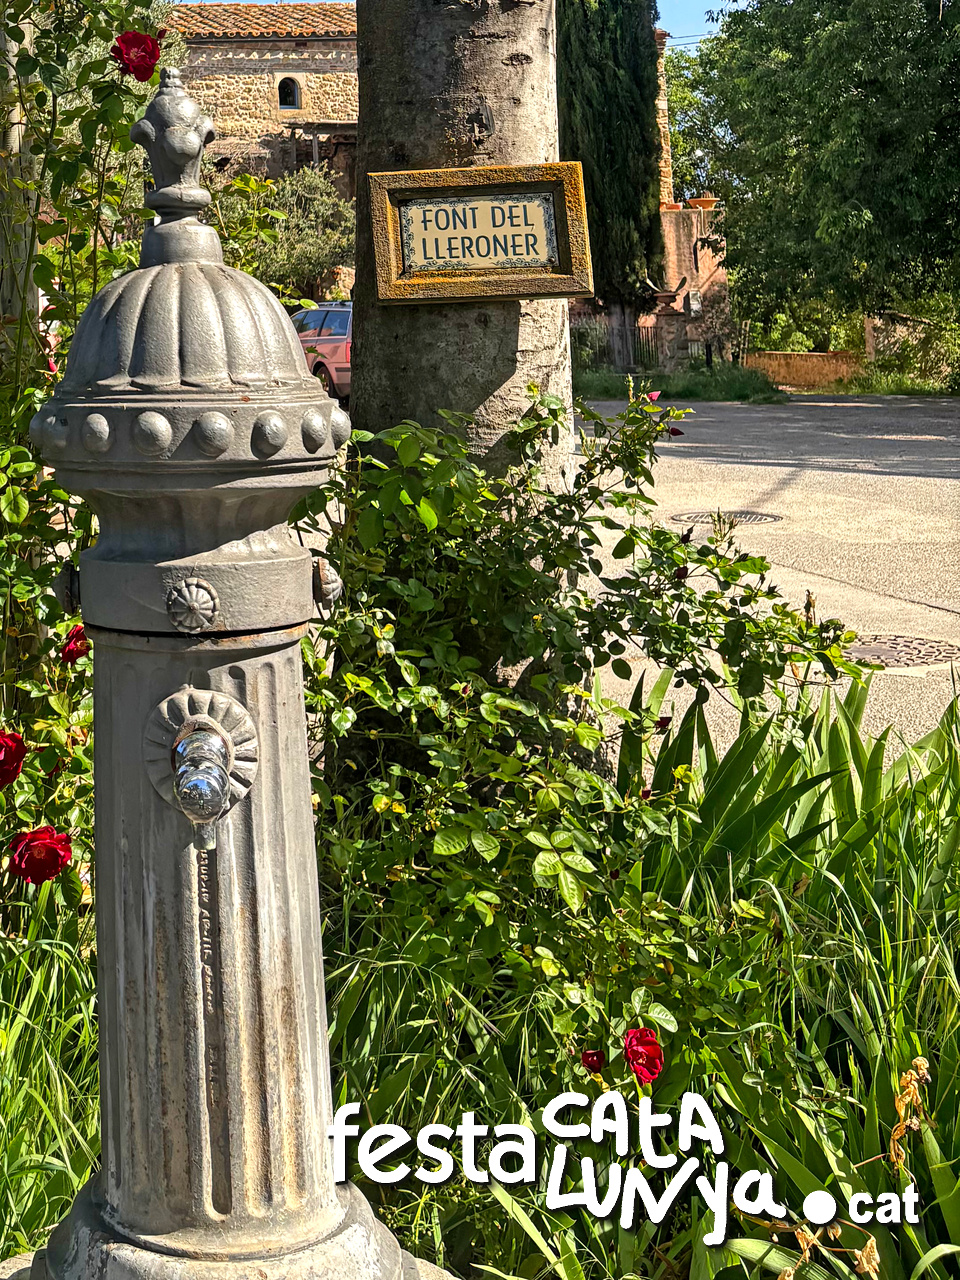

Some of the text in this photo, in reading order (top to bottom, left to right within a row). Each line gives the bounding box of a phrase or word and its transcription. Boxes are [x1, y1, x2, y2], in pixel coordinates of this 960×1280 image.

[421, 204, 535, 231] FONT DEL
[422, 233, 540, 260] LLERONER
